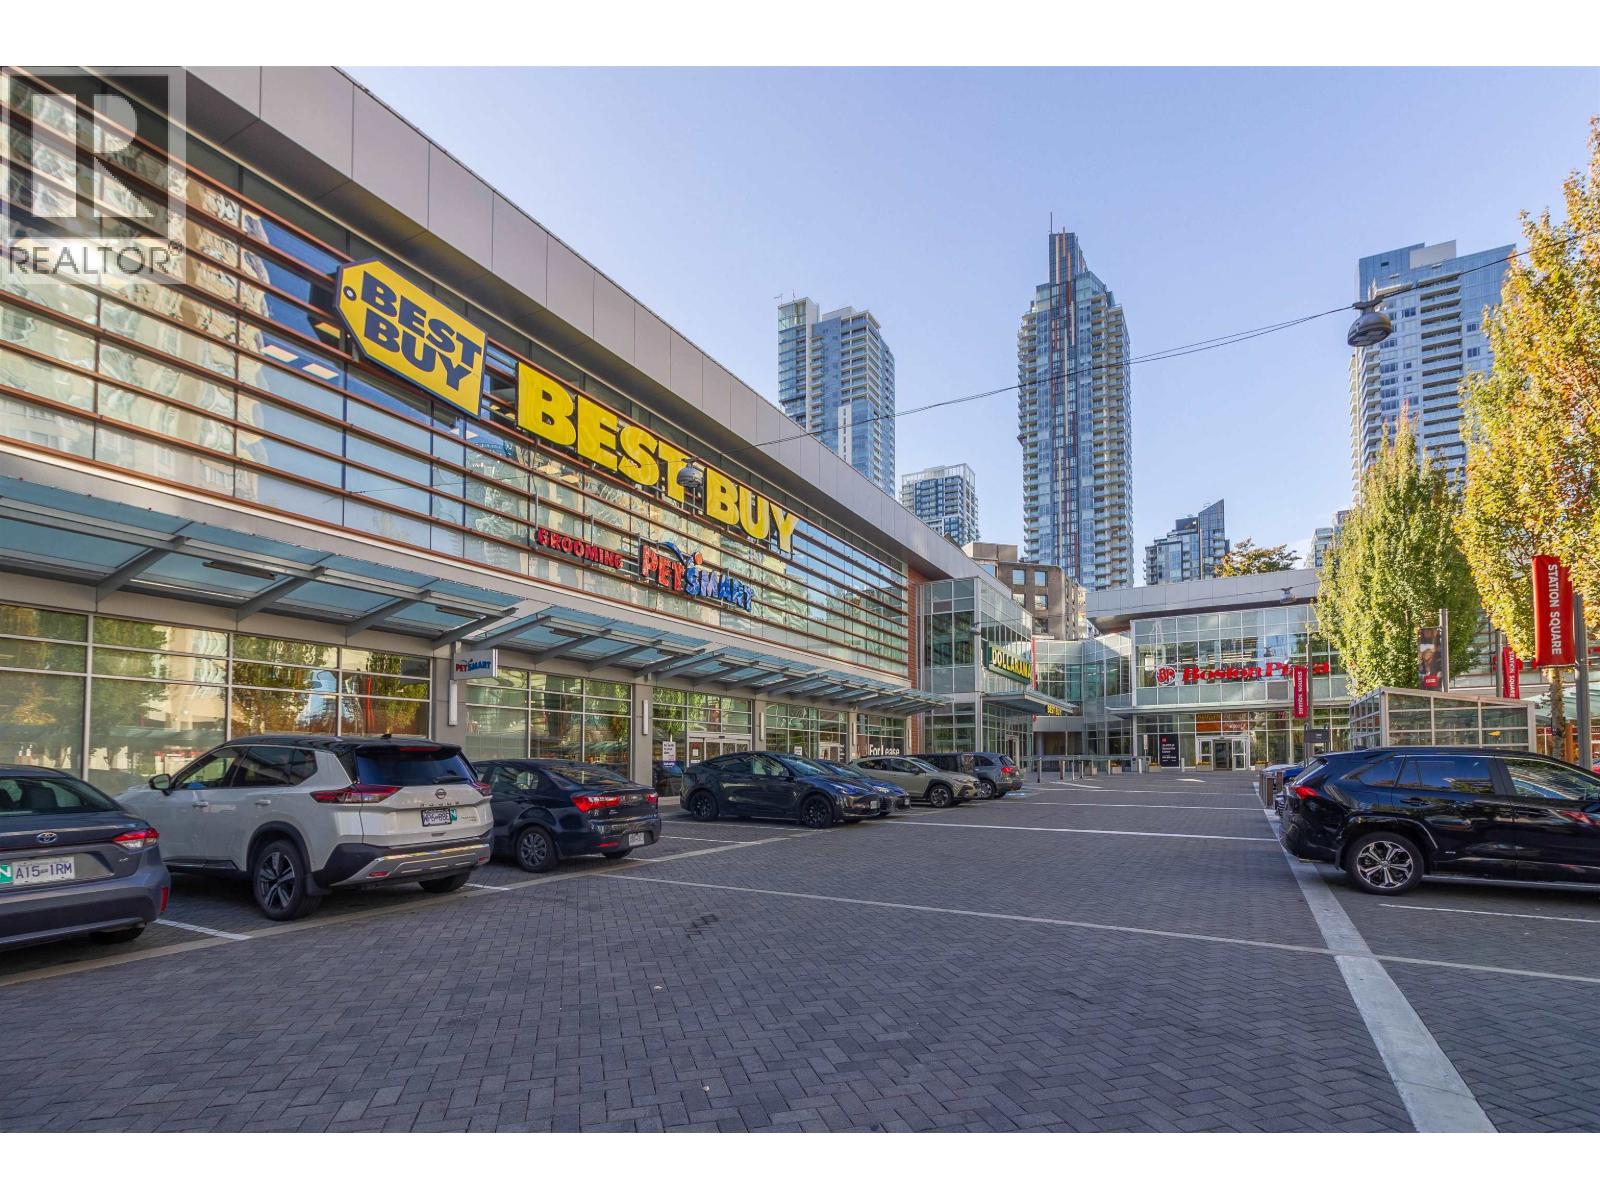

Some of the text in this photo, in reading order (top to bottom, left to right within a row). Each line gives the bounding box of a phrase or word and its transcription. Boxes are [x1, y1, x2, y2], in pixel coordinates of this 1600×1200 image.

[361, 270, 482, 369] BEST
[364, 307, 472, 392] BUY
[518, 361, 799, 553] BEST BUY
[537, 527, 624, 569] GROOMING
[1548, 564, 1562, 655] STATION SQUARE
[456, 660, 491, 672] PETSMART
[992, 645, 1032, 679] DOLLARAMA
[1182, 661, 1330, 683] Boston Pia
